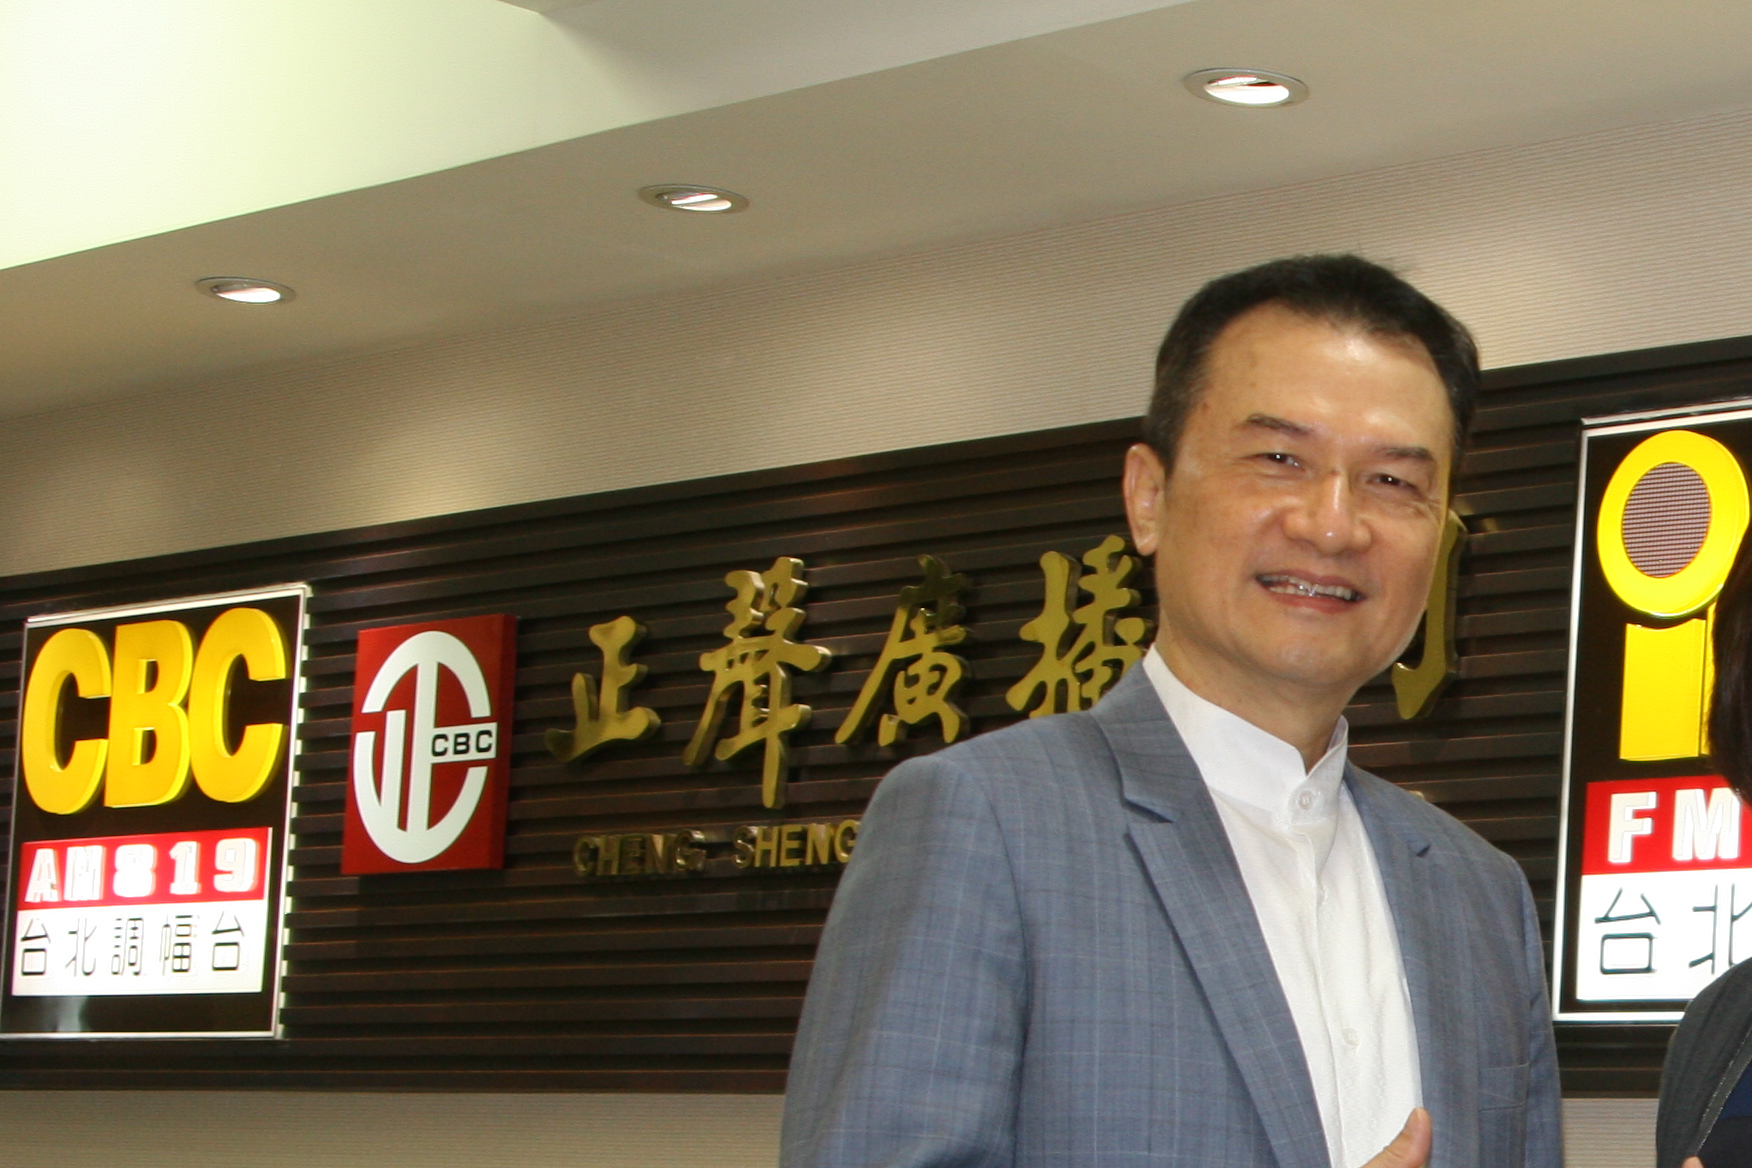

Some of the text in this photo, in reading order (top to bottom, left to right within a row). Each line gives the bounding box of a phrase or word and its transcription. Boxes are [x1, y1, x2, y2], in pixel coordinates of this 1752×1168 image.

[22, 607, 287, 815] CBC
[431, 729, 492, 757] CBC
[574, 819, 860, 877] CHENG SHENG
[19, 910, 246, 976] 台北調幅台
